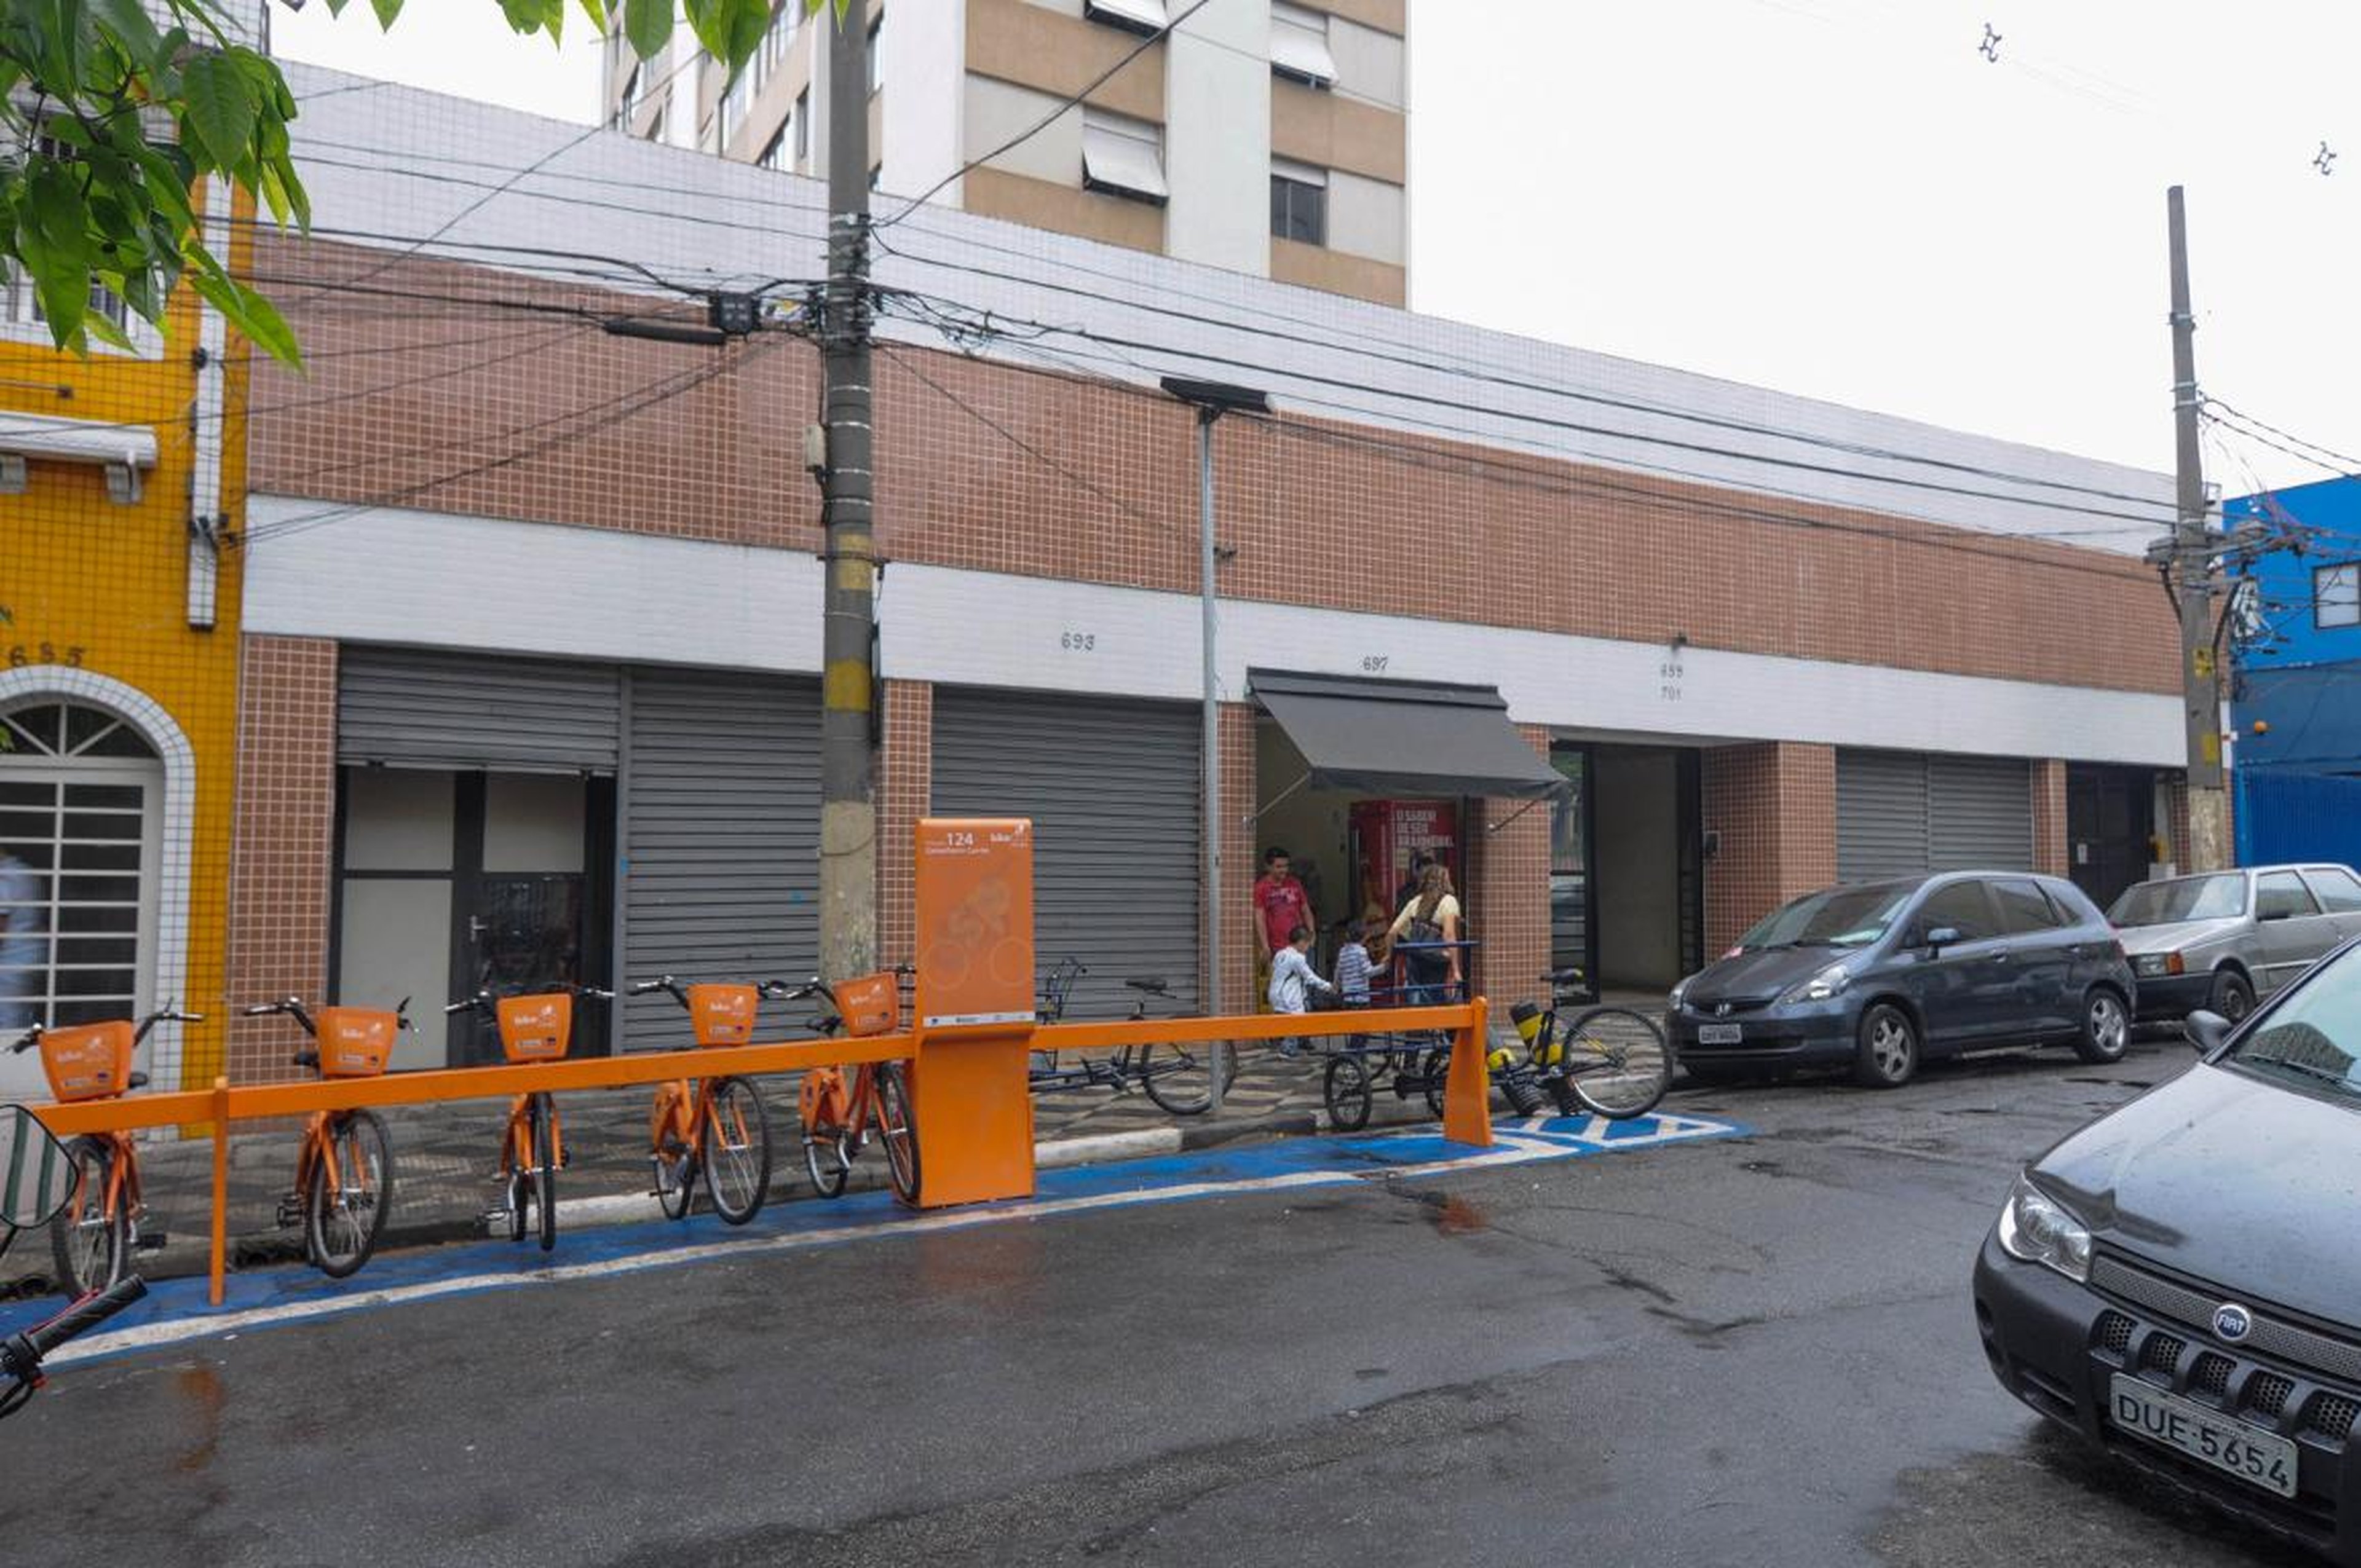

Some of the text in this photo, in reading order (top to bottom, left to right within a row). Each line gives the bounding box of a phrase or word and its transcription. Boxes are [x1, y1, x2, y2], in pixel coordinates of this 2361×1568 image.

[1061, 632, 1095, 651] 693
[1363, 656, 1388, 671] 697
[947, 832, 973, 846] 124
[2218, 1314, 2245, 1333] FIAT
